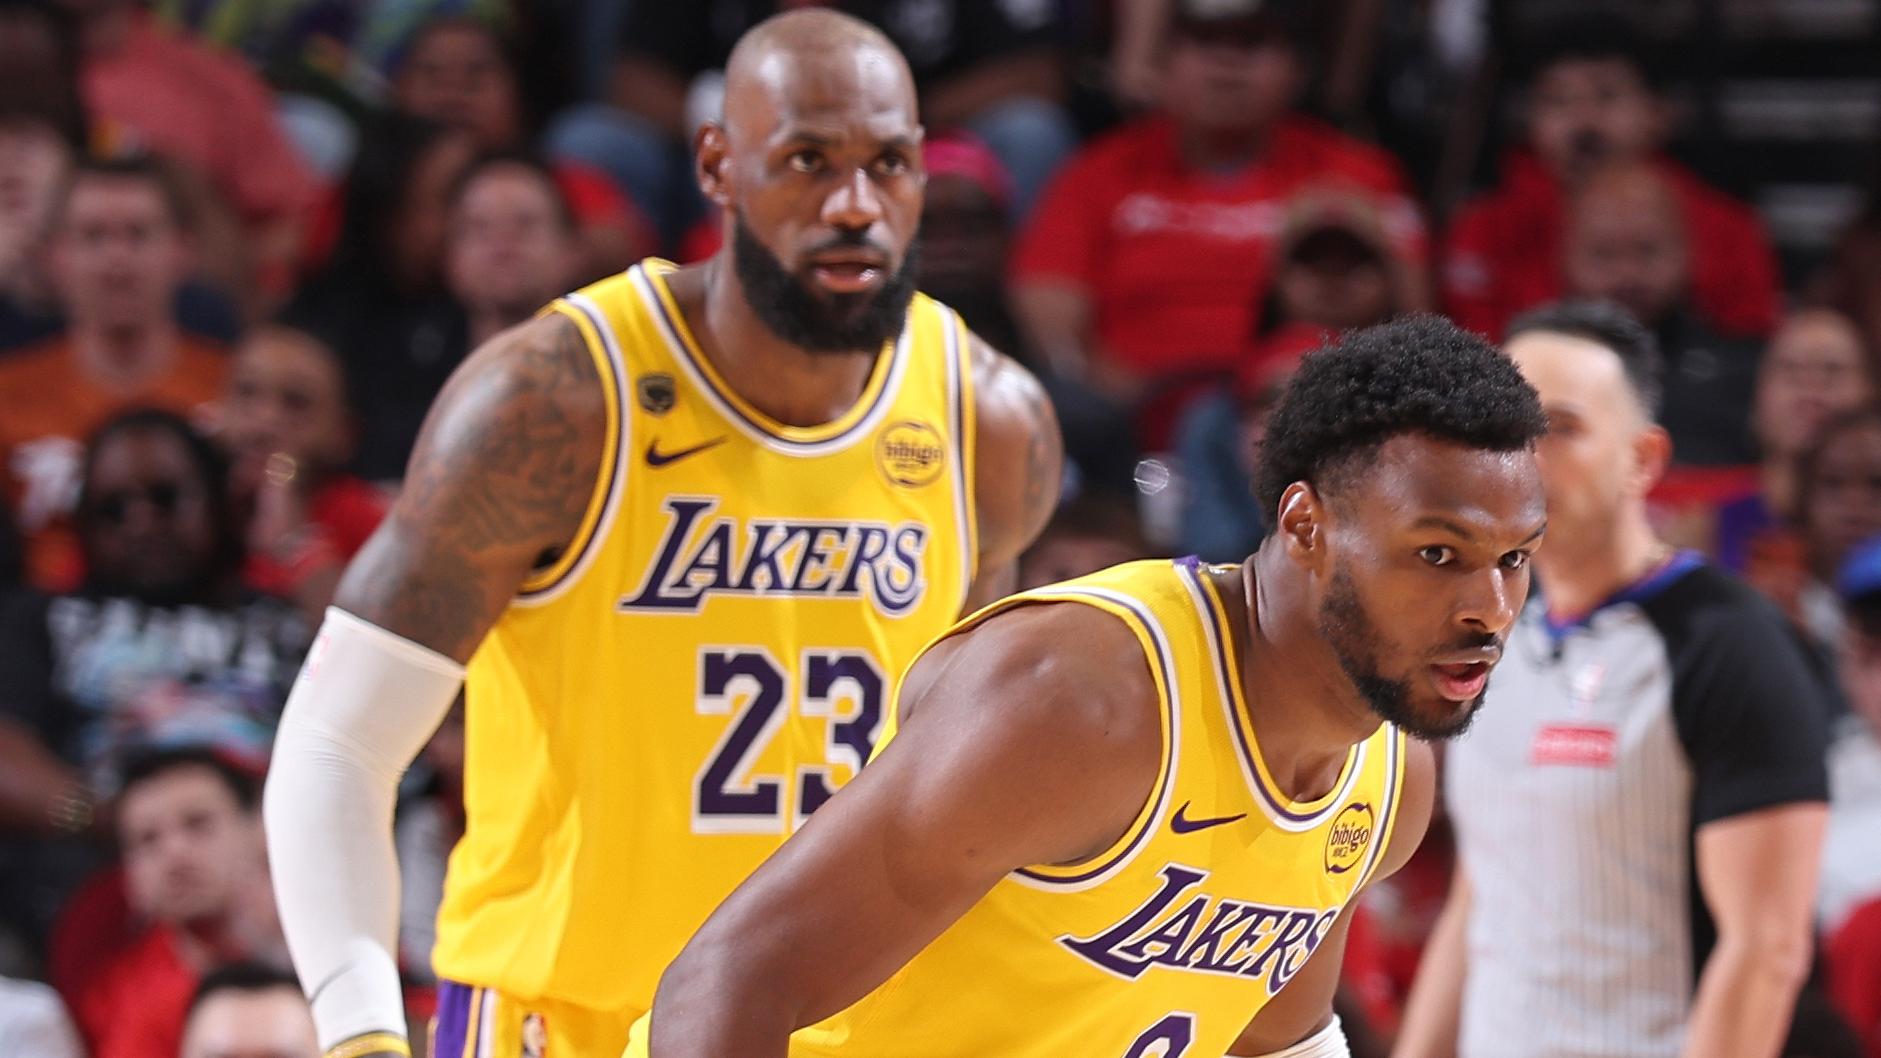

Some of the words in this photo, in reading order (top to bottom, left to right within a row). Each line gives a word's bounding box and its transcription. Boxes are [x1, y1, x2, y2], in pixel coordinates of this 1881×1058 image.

[618, 497, 927, 616] LAKERS
[693, 646, 889, 830] 23
[1331, 822, 1369, 853] bibigo
[1057, 863, 1339, 994] LAKERS
